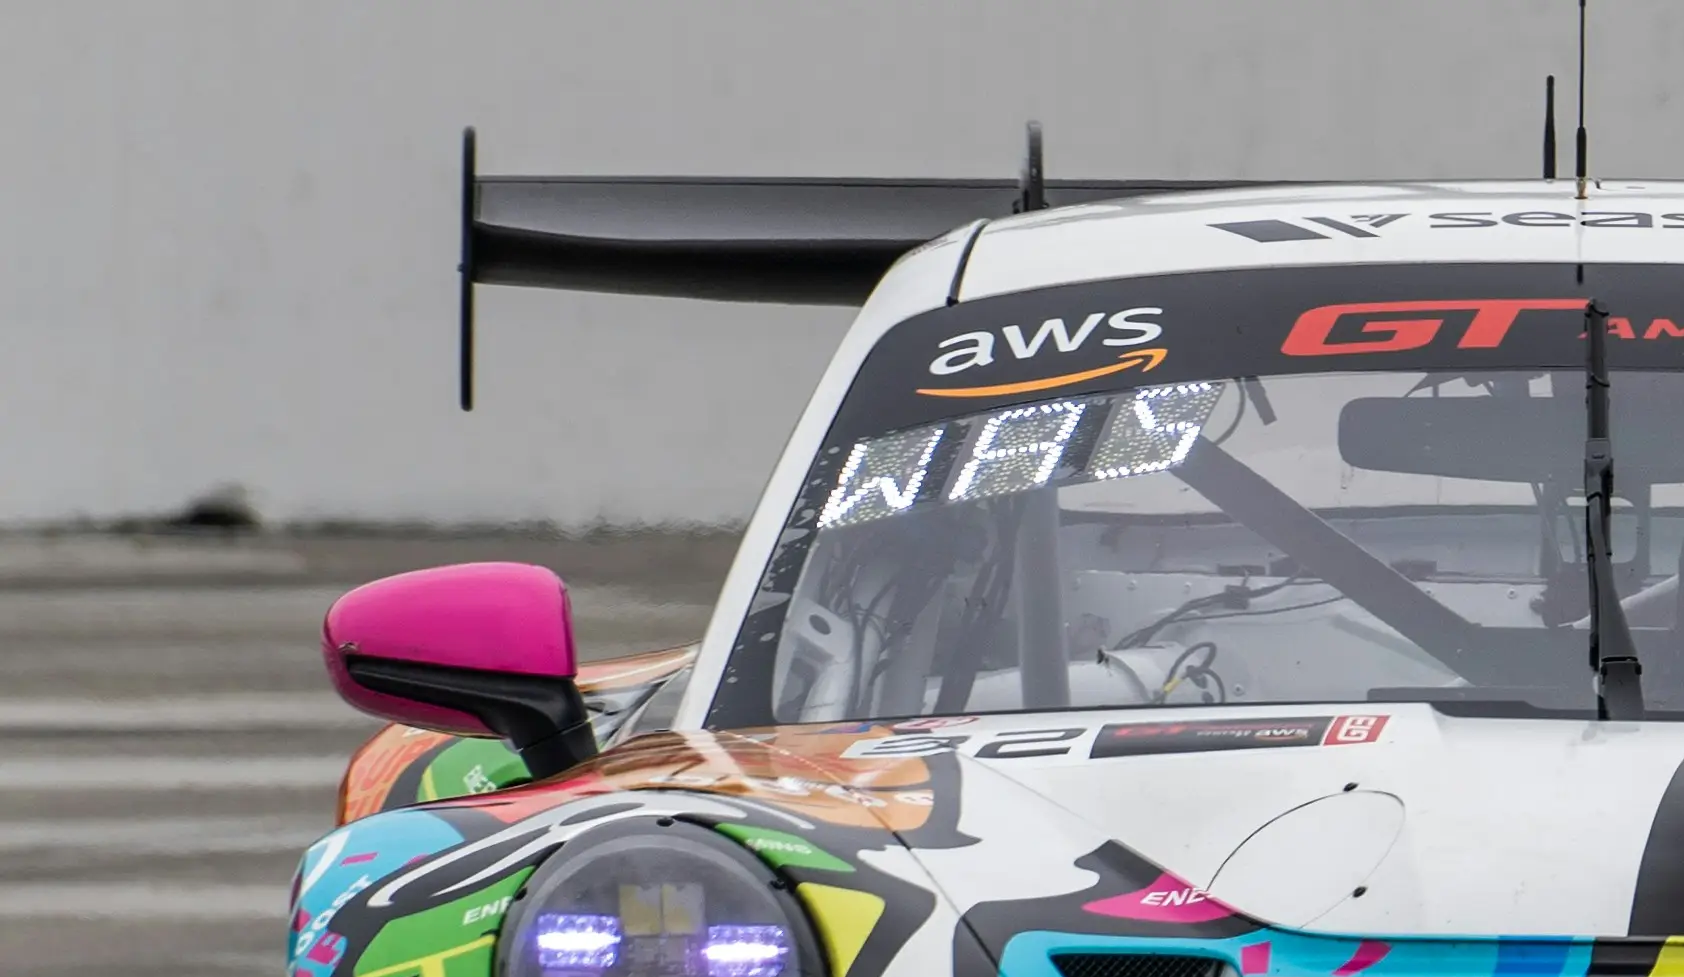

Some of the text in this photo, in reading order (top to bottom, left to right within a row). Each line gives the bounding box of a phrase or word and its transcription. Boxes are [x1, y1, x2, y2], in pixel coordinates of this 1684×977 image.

[928, 306, 1164, 376] aws
[1281, 298, 1592, 357] GT
[817, 380, 1213, 530] WAS
